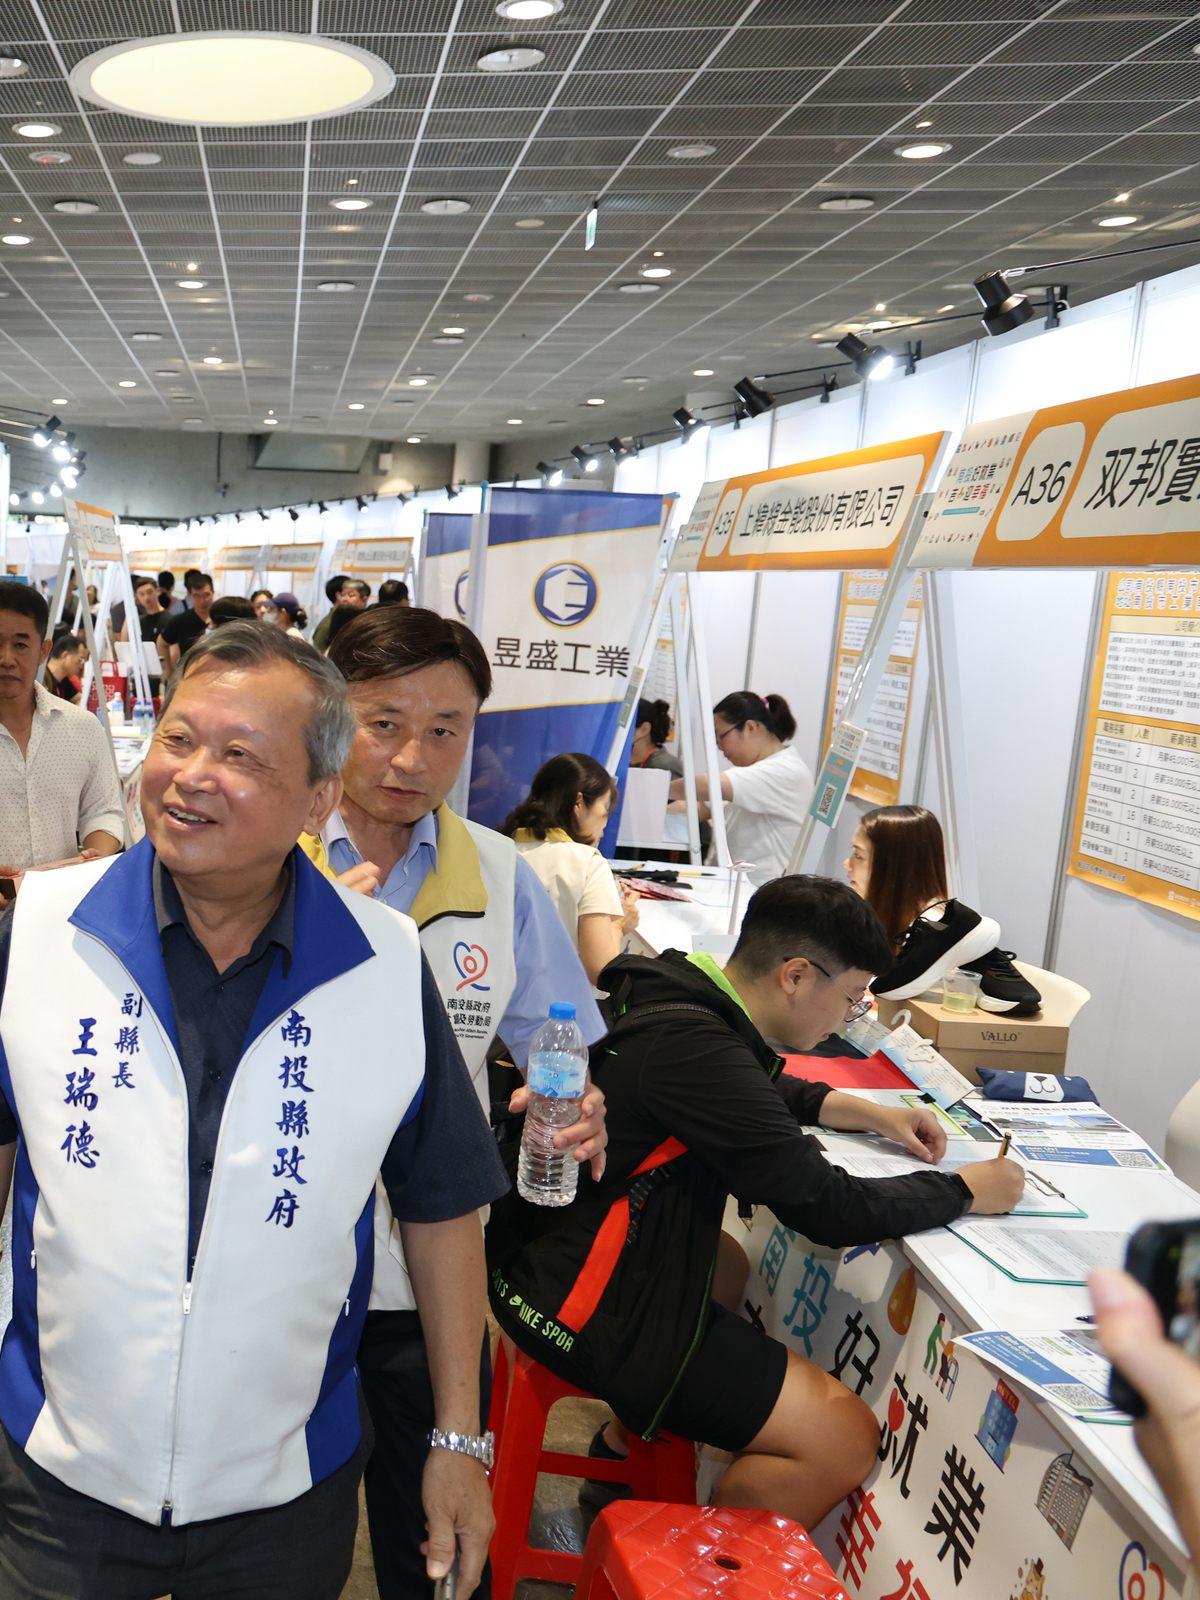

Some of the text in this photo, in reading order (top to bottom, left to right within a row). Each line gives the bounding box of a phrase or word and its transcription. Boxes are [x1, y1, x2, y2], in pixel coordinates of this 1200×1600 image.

[1010, 460, 1073, 507] A36
[1083, 436, 1200, 510] 双邦實
[712, 510, 736, 536] A35
[492, 636, 631, 678] 昱盛工業
[112, 992, 144, 1091] 副縣長
[981, 1031, 1018, 1042] VALLO
[60, 1017, 101, 1170] 王瑞德
[264, 1009, 315, 1229] 南投縣政府
[518, 1302, 544, 1329] NIKE
[541, 1321, 575, 1353] SPOR
